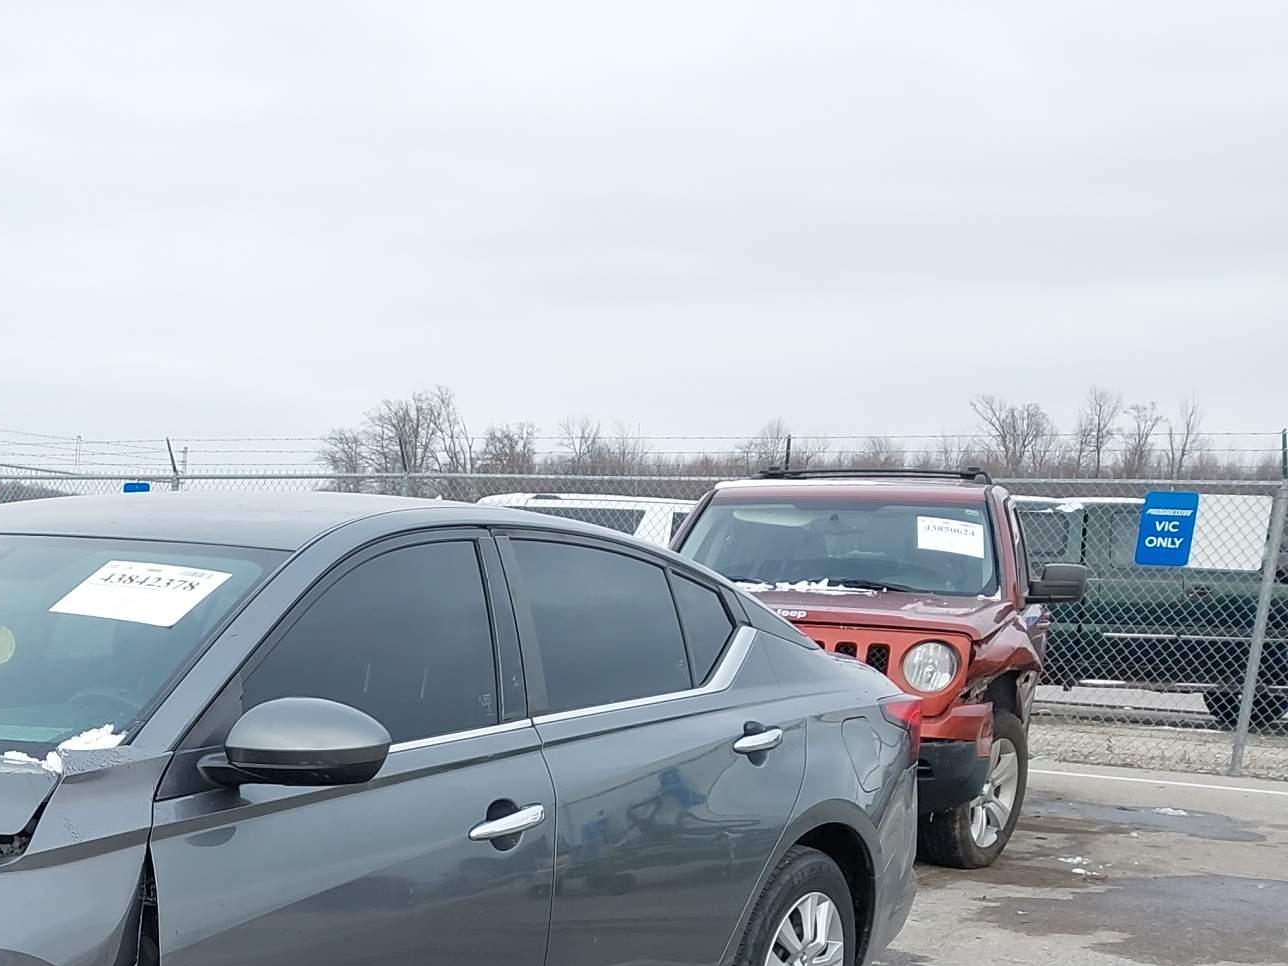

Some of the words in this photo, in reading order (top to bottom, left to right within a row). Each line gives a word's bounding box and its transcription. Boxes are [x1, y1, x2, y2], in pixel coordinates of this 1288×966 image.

[1155, 520, 1180, 532] VIC
[1144, 536, 1184, 548] ONLY
[100, 572, 200, 592] 43842378
